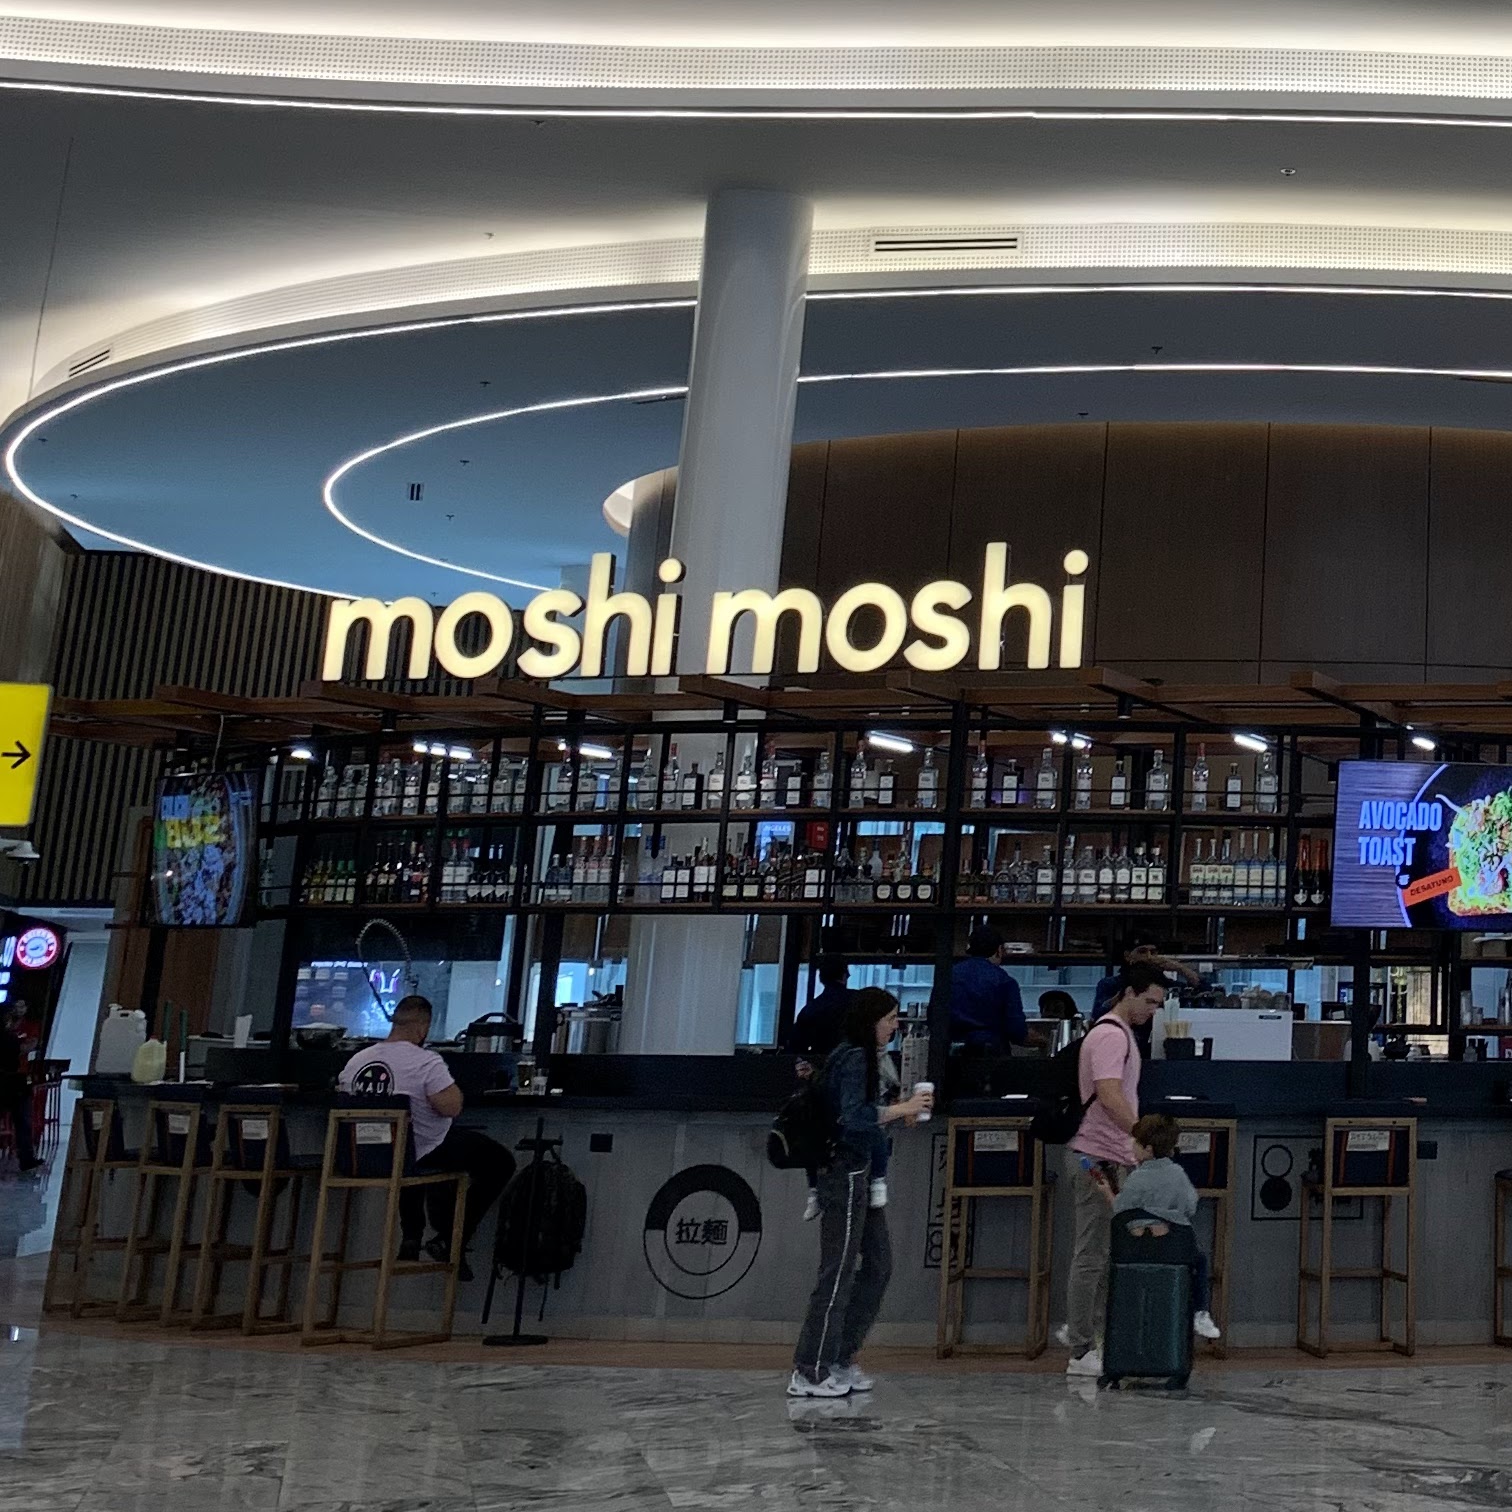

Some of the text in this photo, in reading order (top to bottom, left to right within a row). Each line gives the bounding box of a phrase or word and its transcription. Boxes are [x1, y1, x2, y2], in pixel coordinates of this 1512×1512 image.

[321, 542, 1090, 681] moshi moshi
[1358, 800, 1443, 832] AVOCADO
[1358, 836, 1417, 866] TOAST
